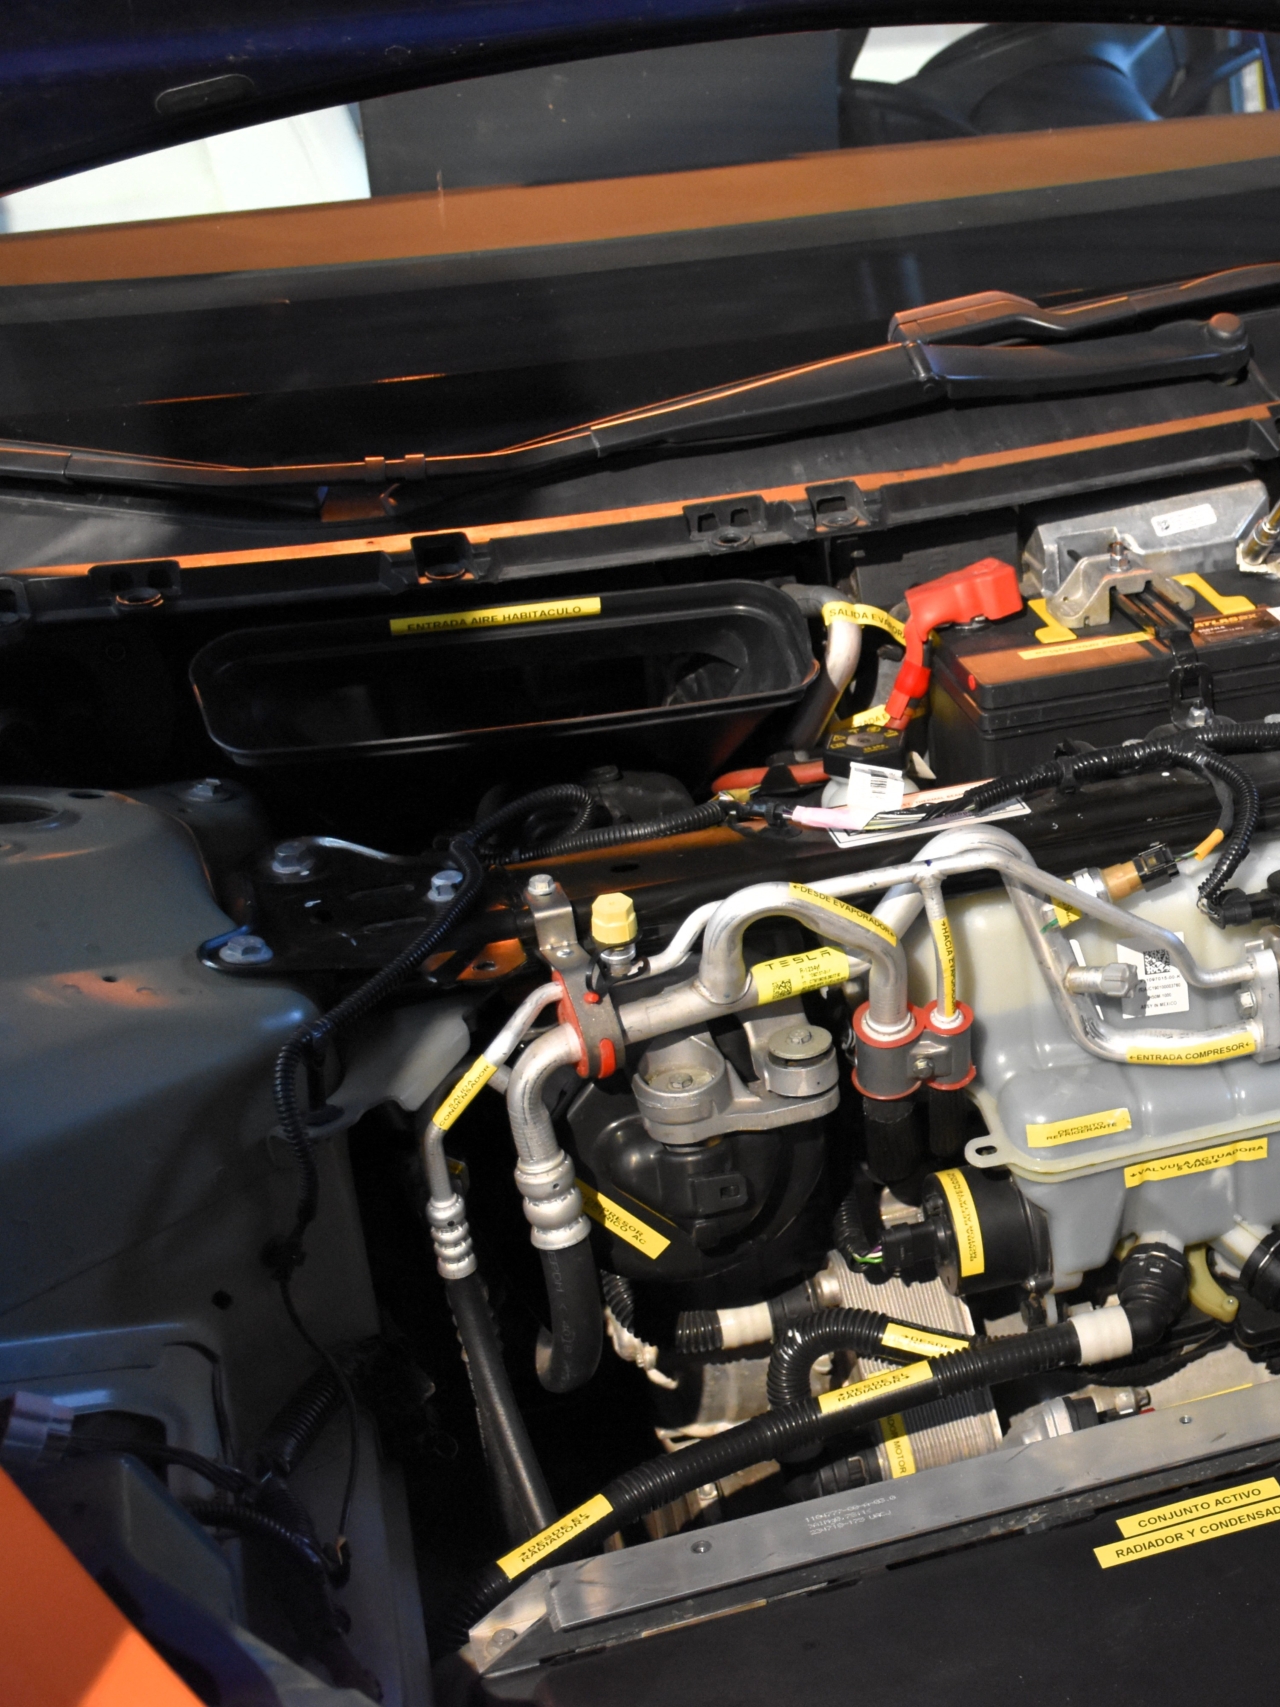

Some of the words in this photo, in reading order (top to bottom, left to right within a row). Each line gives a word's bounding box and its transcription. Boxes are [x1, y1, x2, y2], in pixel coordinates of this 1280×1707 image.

[407, 619, 467, 632] ENTRADA
[470, 614, 498, 626] AIRE
[502, 606, 582, 622] HABITACULO
[829, 608, 869, 620] SALIDA
[800, 886, 831, 903] DESDE
[833, 900, 891, 935] EVAPORADOR
[942, 926, 953, 957] HACIA
[765, 949, 831, 970] TESLA
[1185, 1042, 1245, 1060] COMPRESOR
[439, 1065, 490, 1127] CONDENSADOR
[448, 1080, 472, 1108] SALIDA
[1046, 1122, 1118, 1141] REFRIGERANTE
[1057, 1121, 1105, 1135] DEPOSITO
[1138, 1161, 1191, 1176] VALVULA
[1193, 1145, 1264, 1165] ACTUADORA
[1186, 1160, 1213, 1170] VIAS
[963, 1200, 972, 1223] ALTA
[632, 1234, 647, 1245] AC
[966, 1228, 974, 1262] BOMBA
[969, 1226, 978, 1259] MOTOR
[911, 1336, 953, 1350] DESDE
[838, 1377, 902, 1402] RADIADOR
[846, 1378, 886, 1395] DESDE
[893, 1373, 909, 1381] EL
[893, 1440, 907, 1474] MOTOR
[1138, 1502, 1211, 1529] CONJUNTO
[1215, 1488, 1262, 1507] ACTIVO
[521, 1520, 583, 1563] RADIADOR
[527, 1523, 569, 1552] DESDE
[571, 1513, 587, 1524] EL
[1115, 1532, 1185, 1559] RADIADOR
[1187, 1529, 1197, 1538] Y
